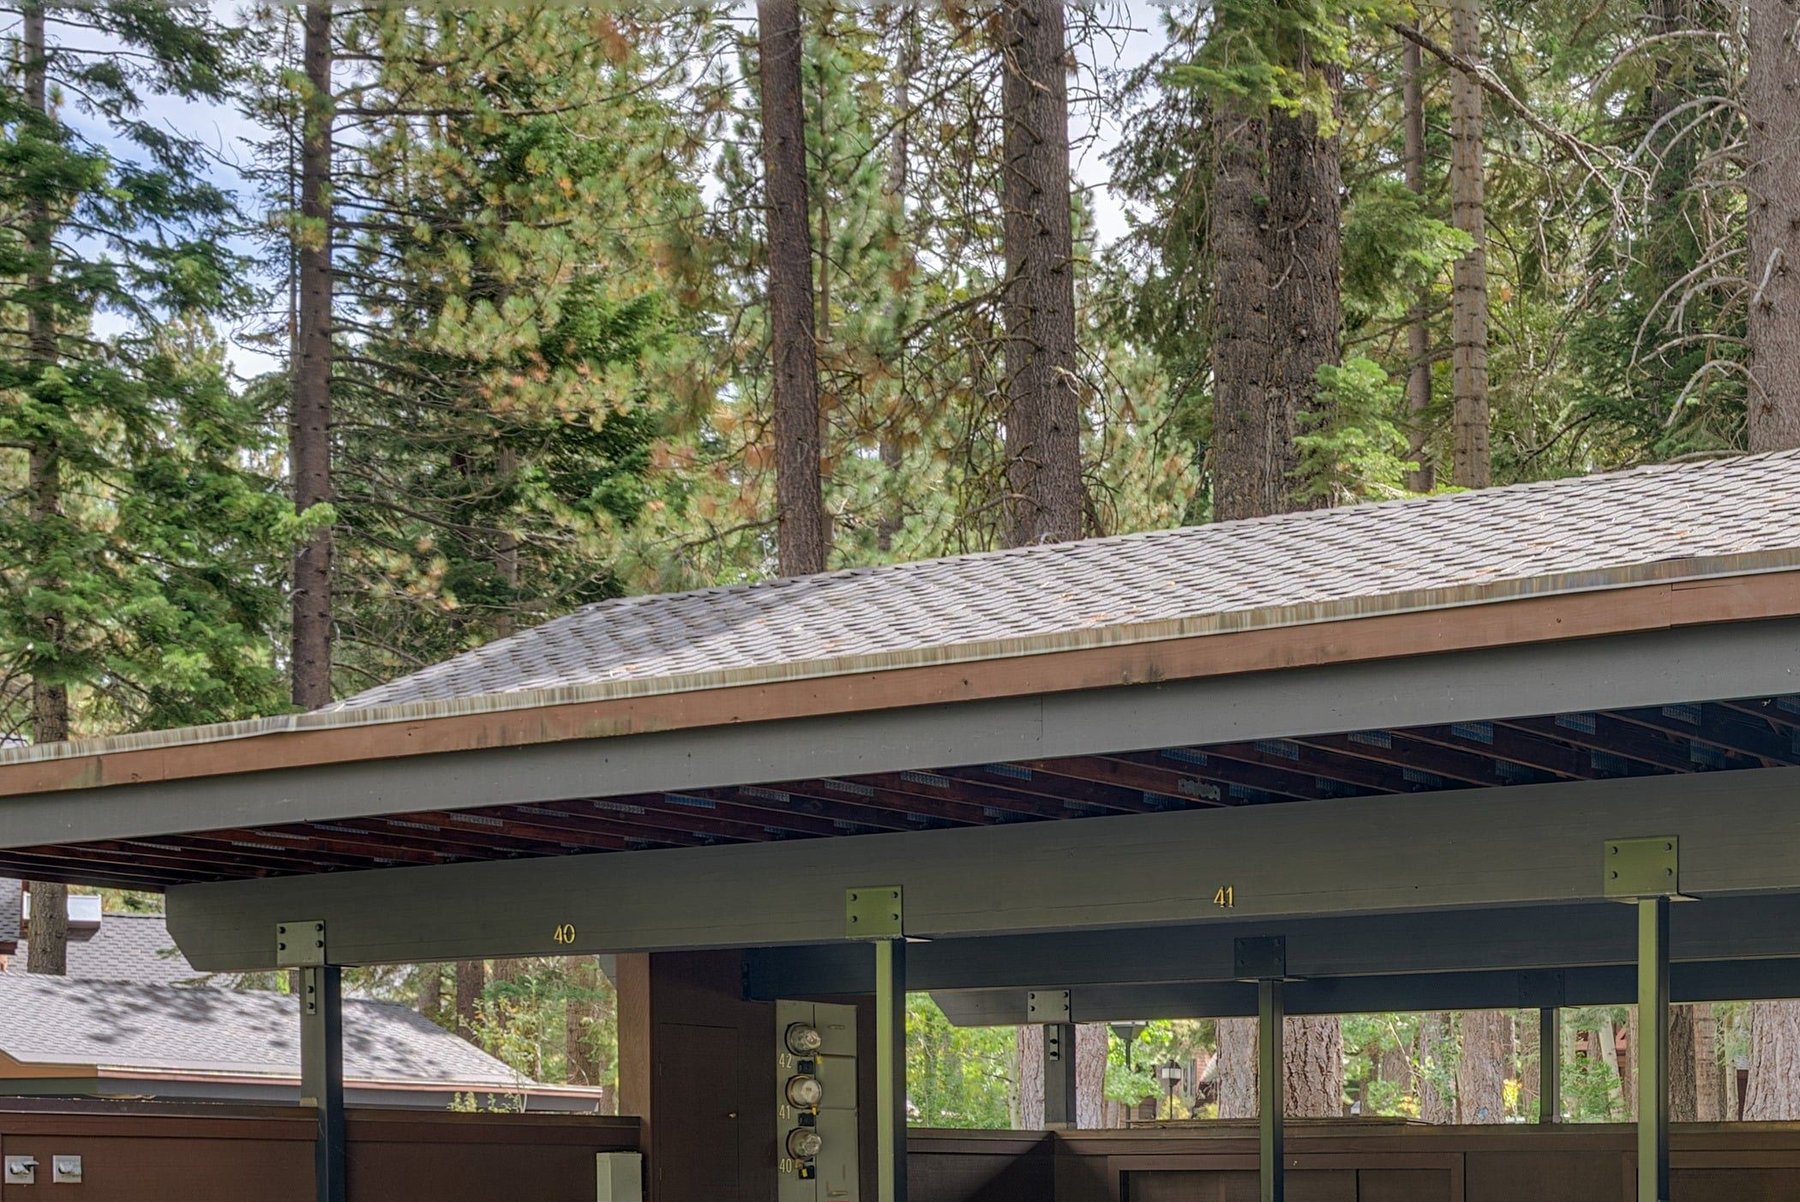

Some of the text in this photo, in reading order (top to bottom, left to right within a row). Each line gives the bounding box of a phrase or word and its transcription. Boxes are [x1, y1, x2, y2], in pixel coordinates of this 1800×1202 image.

[1213, 886, 1233, 907] 41
[553, 924, 576, 944] 40
[779, 1053, 792, 1068] 42
[779, 1104, 791, 1119] 41
[779, 1158, 793, 1173] 40
